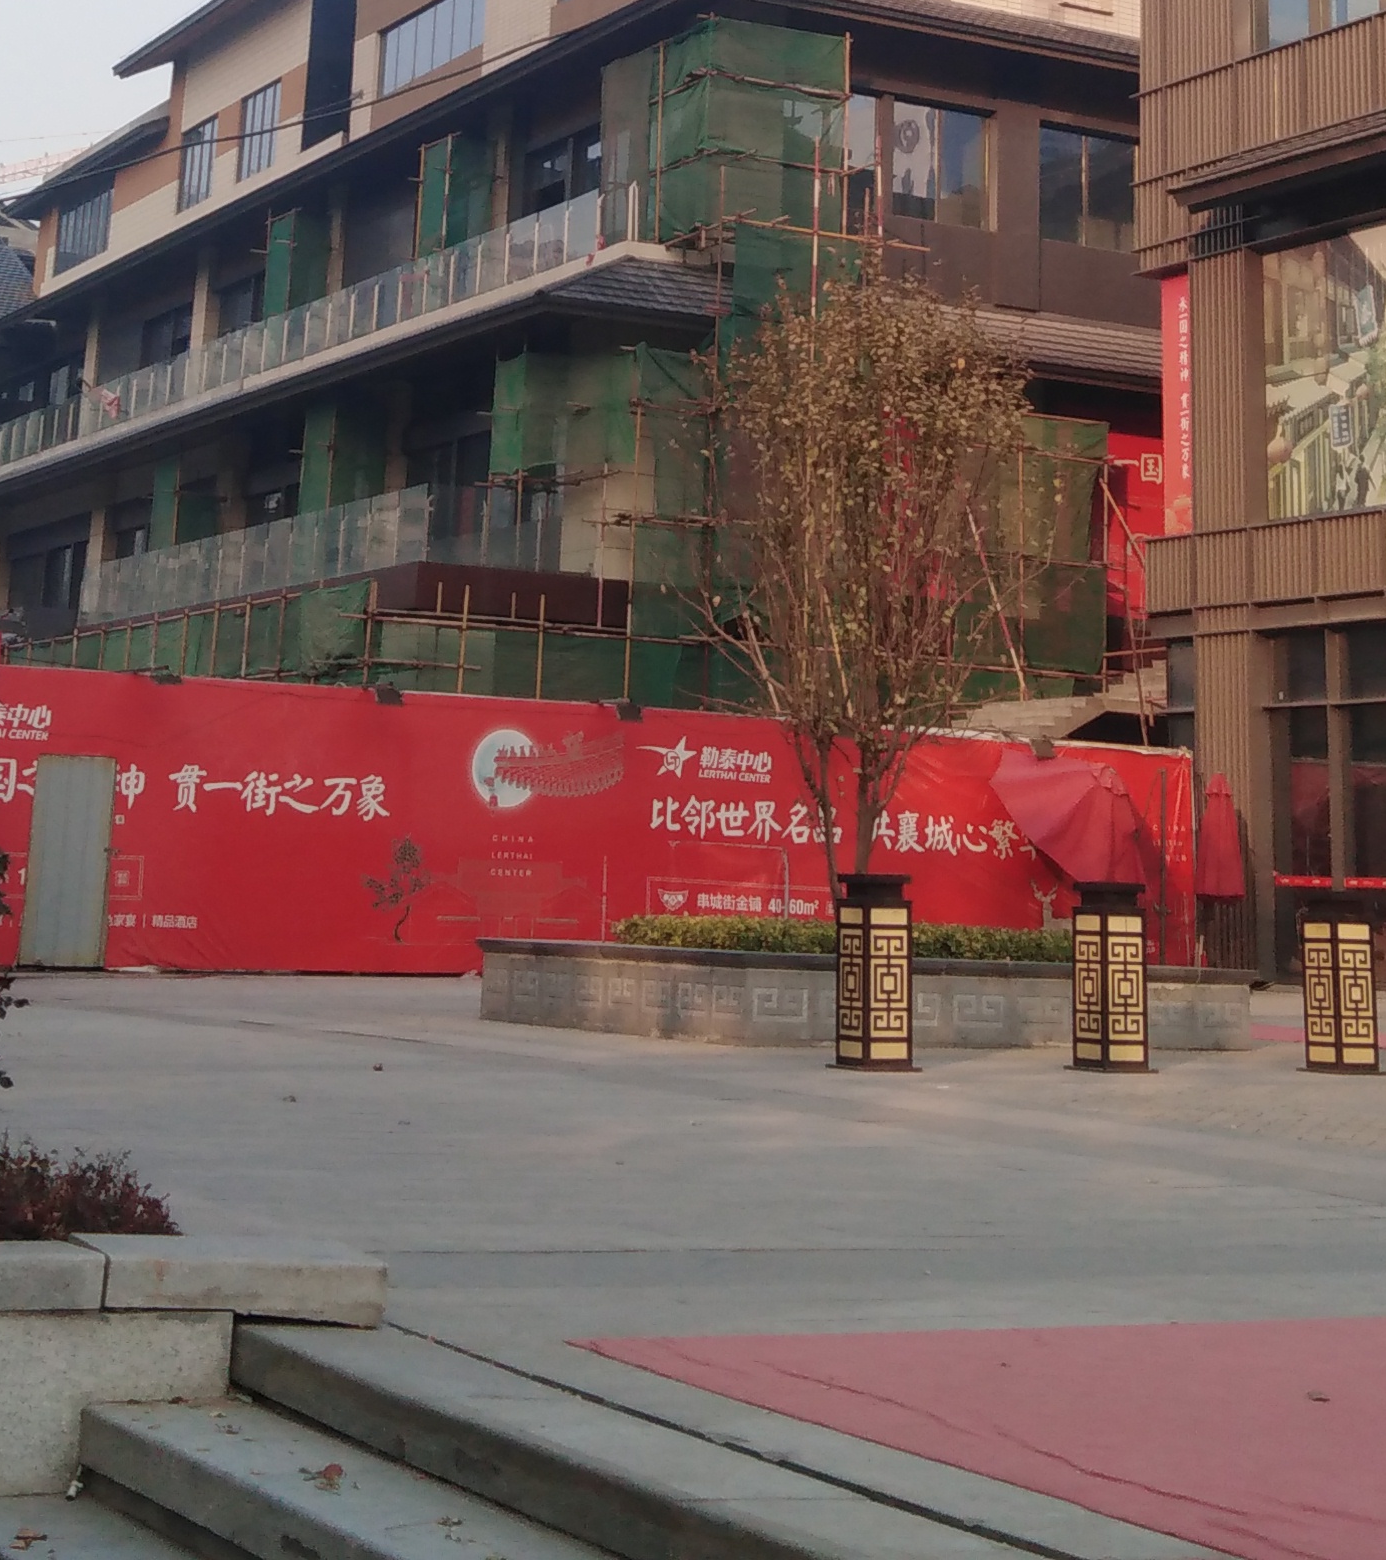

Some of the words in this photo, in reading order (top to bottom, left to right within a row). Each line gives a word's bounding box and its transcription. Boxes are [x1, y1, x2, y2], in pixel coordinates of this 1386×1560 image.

[700, 746, 772, 773] 勒泰中心
[698, 769, 737, 781] LERTHAI
[738, 772, 771, 783] CENTER
[168, 763, 391, 822] 贯一街之万象
[151, 914, 199, 929] 精品酒店
